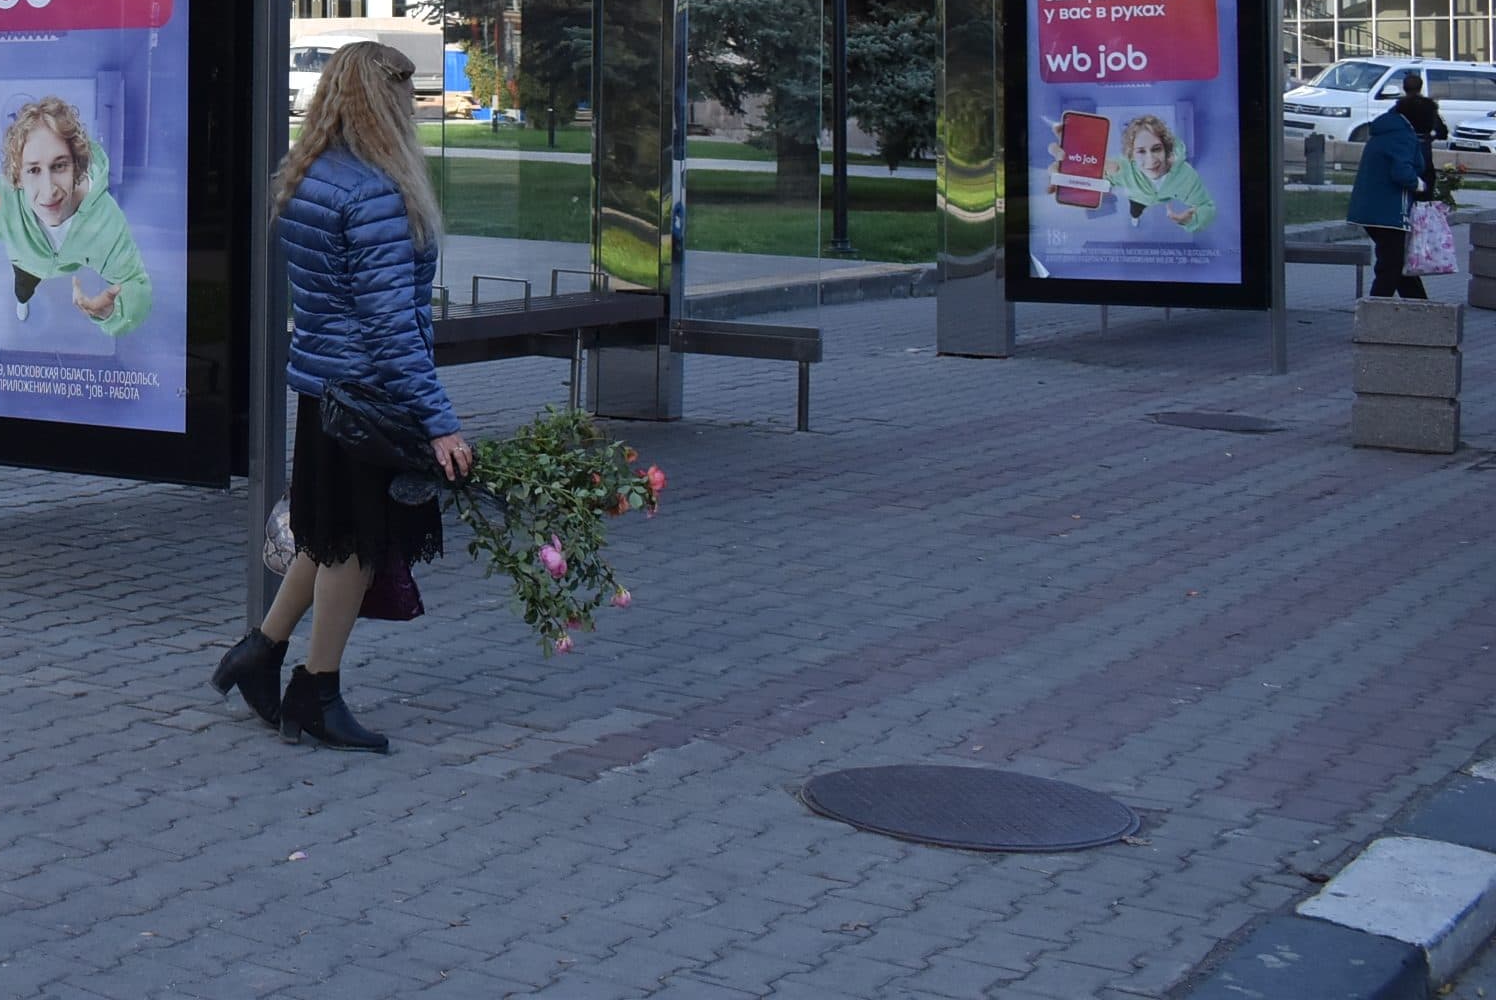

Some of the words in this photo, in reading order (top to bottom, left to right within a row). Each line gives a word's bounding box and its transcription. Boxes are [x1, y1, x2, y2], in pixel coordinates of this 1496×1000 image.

[1043, 8, 1056, 24] у
[1059, 6, 1092, 20] вас
[1096, 6, 1107, 19] в
[1111, 4, 1166, 22] руках
[1045, 45, 1092, 73] wb
[1096, 43, 1148, 79] job
[1068, 153, 1082, 162] wb
[1082, 153, 1098, 165] job
[7, 364, 59, 379] МОСКОВСКАЯ
[54, 383, 67, 395] WB
[109, 388, 140, 400] РАБОТА
